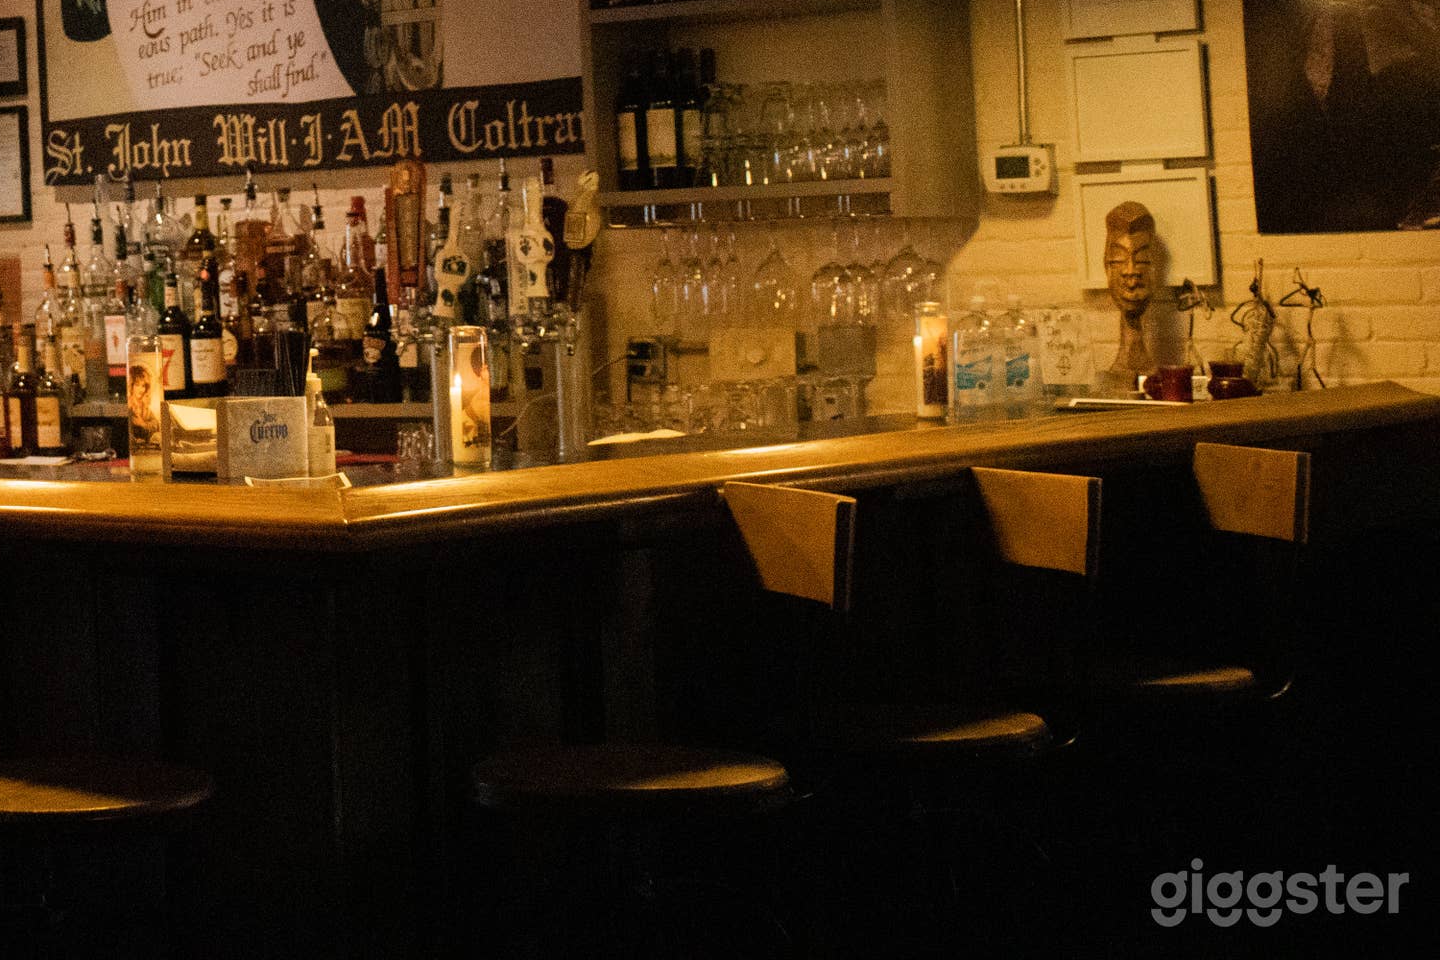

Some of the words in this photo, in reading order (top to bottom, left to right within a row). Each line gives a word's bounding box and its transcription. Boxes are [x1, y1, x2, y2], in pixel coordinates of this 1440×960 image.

[129, 0, 167, 38] Him
[138, 36, 171, 60] eous
[225, 6, 254, 38] Yes
[262, 1, 274, 22] it
[246, 28, 281, 62] and
[287, 30, 305, 60] ye
[247, 63, 283, 96] shall
[45, 129, 93, 184] St.
[105, 122, 192, 182] John
[448, 99, 584, 153] Coltra
